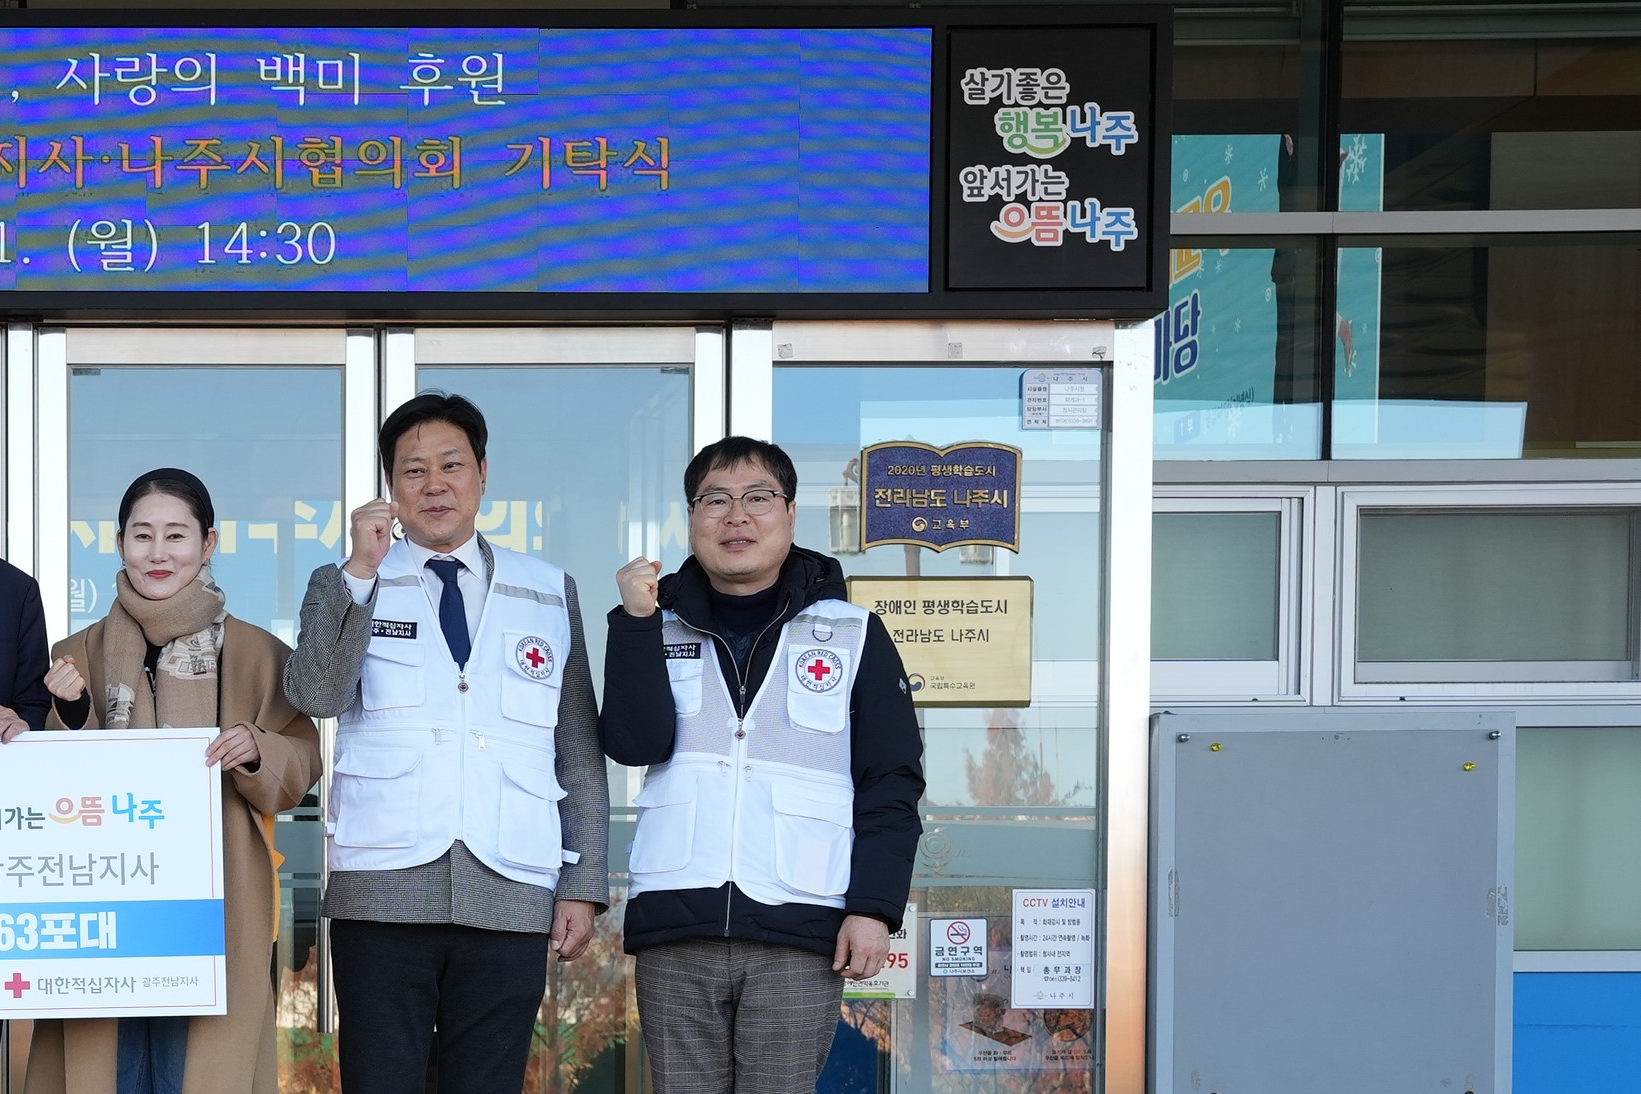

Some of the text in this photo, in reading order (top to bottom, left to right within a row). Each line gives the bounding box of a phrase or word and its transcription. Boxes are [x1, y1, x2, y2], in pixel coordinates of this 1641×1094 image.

[56, 52, 218, 106] 사랑의
[258, 52, 361, 106] 백미
[401, 52, 506, 105] 후원
[962, 69, 1068, 103] 살기좋은
[505, 136, 670, 190] 기탁식
[961, 167, 1067, 200] 앞서가는
[68, 218, 159, 273] (월)
[196, 221, 335, 265] 14:30
[887, 465, 996, 477] 2020년 평생학습도시
[874, 488, 1009, 508] 전라남도 나주시
[932, 519, 970, 530] 교육부
[874, 600, 1008, 615] 장애인 평생학습도시
[892, 629, 989, 643] 전라남도 나주시
[1023, 898, 1086, 908] CCTV 설치안내
[935, 946, 983, 956] 금연구역
[882, 953, 908, 969] 95
[37, 976, 199, 995] 대한적십자사 광주전남지사
